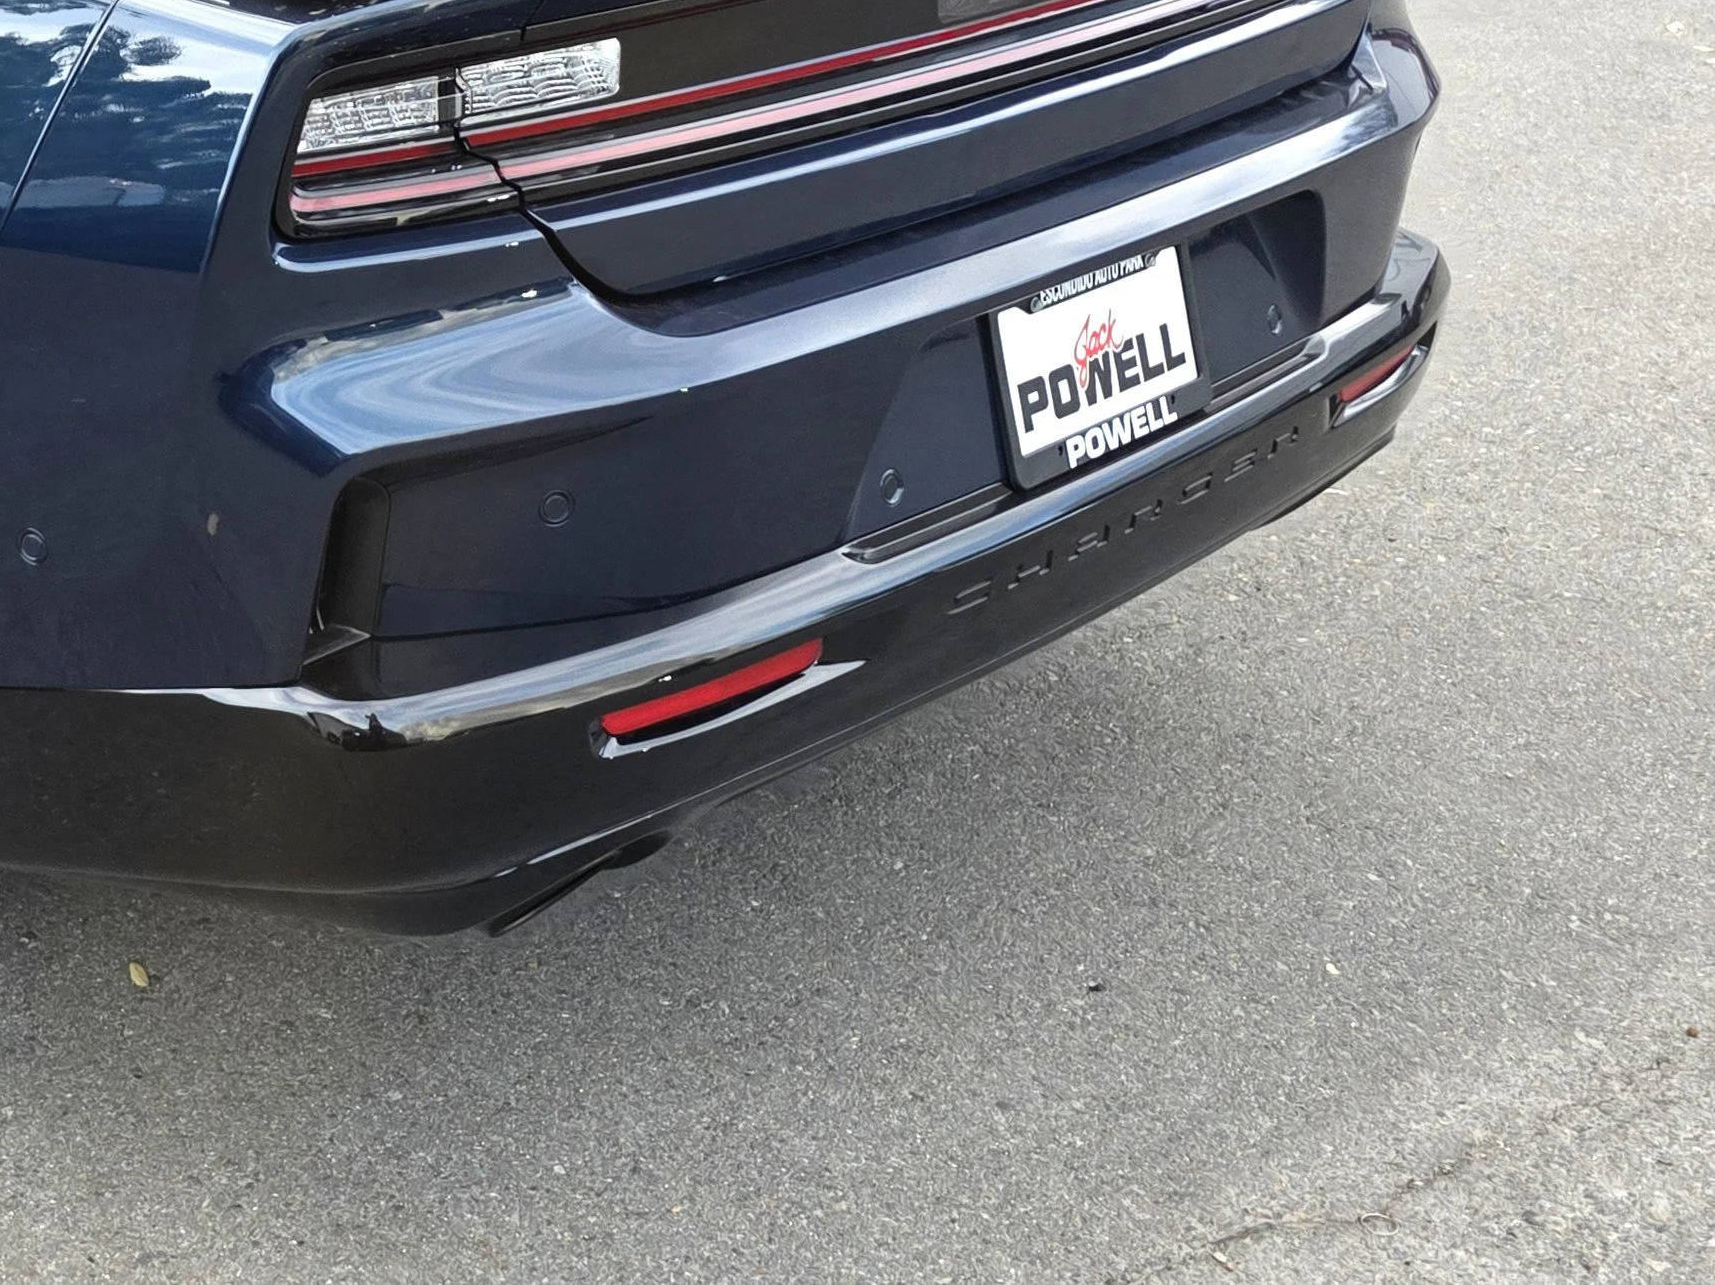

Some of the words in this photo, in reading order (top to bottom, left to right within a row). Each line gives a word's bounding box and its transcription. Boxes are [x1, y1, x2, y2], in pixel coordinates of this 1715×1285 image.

[1040, 272, 1094, 306] ESCONDIDO
[1094, 262, 1119, 286] AUTO
[1119, 254, 1145, 277] PARK
[1017, 322, 1187, 434] POWELL
[1074, 308, 1124, 389] Jack
[1065, 395, 1179, 469] POWELL
[948, 425, 1299, 615] CHARGER
